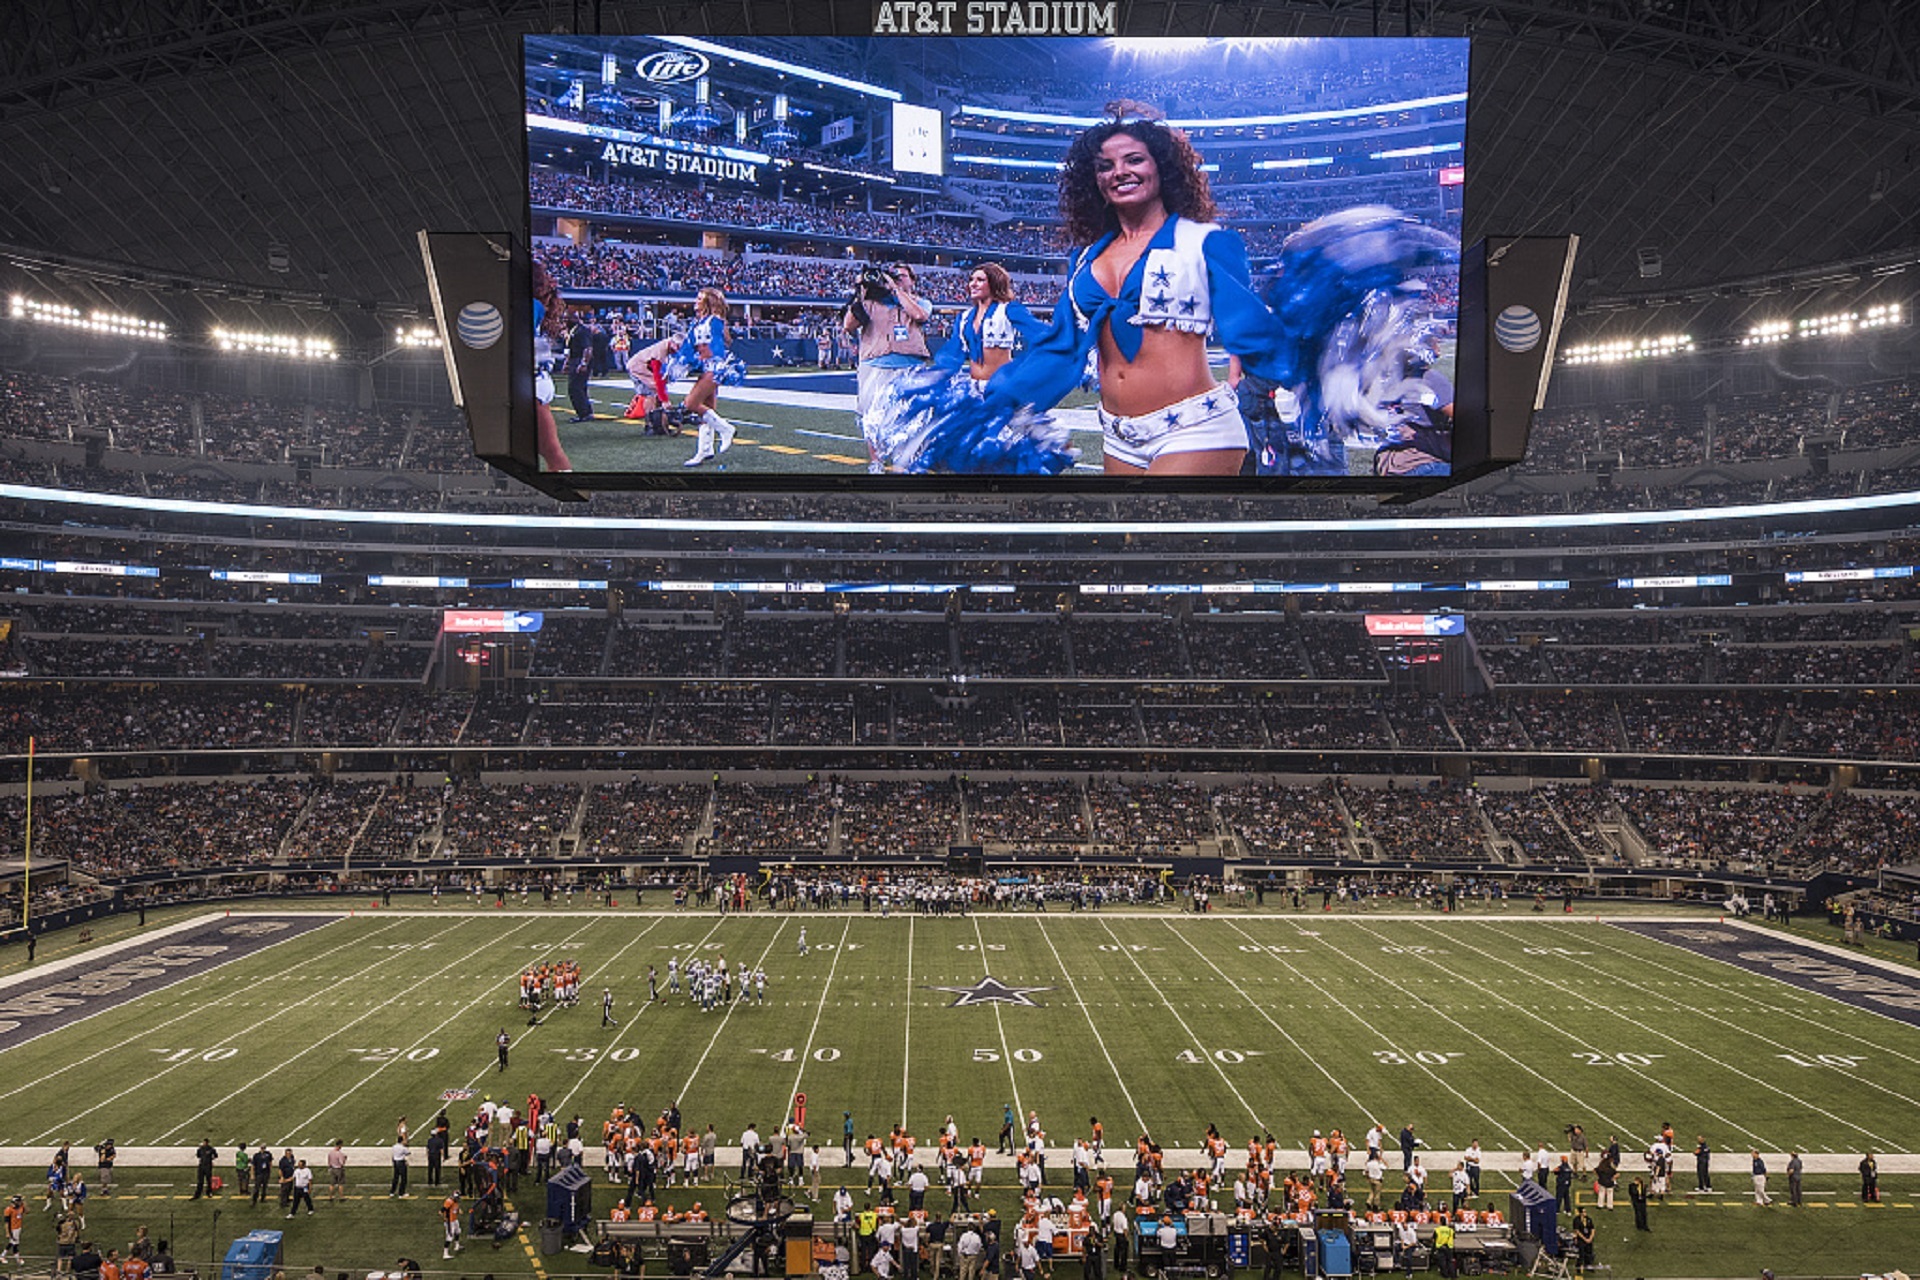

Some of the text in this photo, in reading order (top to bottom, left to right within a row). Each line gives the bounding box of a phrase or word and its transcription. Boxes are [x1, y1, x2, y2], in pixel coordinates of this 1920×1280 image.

[873, 1, 1117, 35] AT&T STADIUM
[601, 142, 660, 167] AT&T
[665, 150, 757, 183] STADIUM
[157, 1048, 239, 1062] 10
[359, 1048, 440, 1062] 20
[565, 1048, 641, 1062] 30
[770, 1048, 842, 1062] 40
[972, 1048, 1043, 1062] 50
[1176, 1049, 1246, 1064] 40
[1372, 1050, 1449, 1065] 30
[1571, 1052, 1654, 1066] 20
